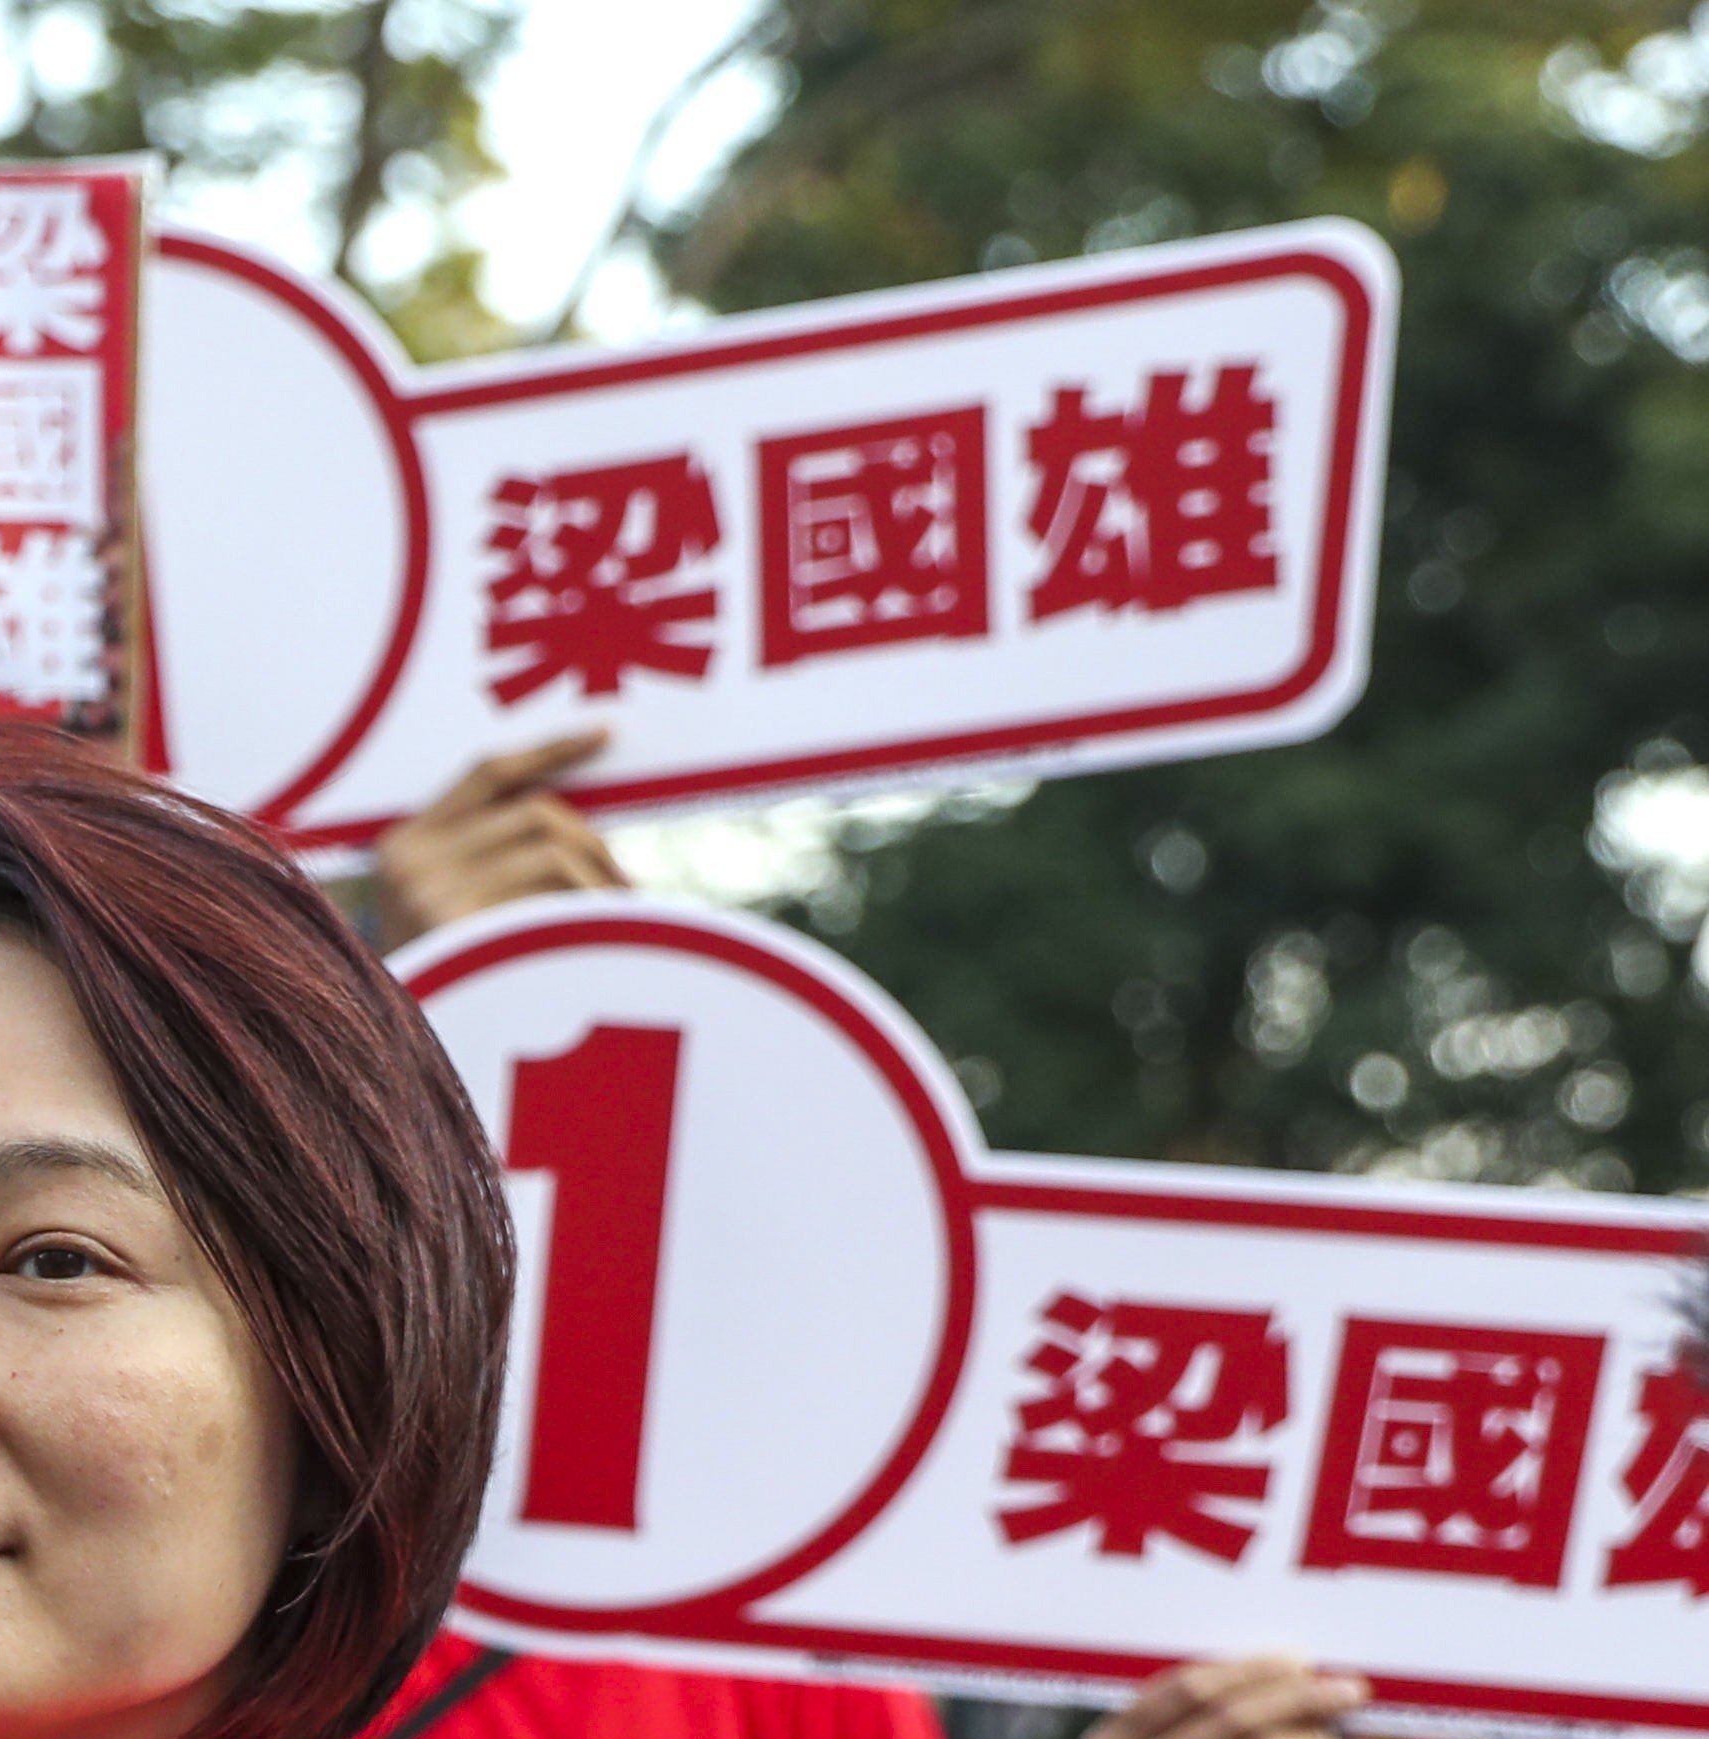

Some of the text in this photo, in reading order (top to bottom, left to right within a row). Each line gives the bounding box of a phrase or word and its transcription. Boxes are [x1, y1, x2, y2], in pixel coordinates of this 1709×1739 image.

[478, 361, 1283, 709] 梁國雄
[505, 1023, 682, 1532] 1
